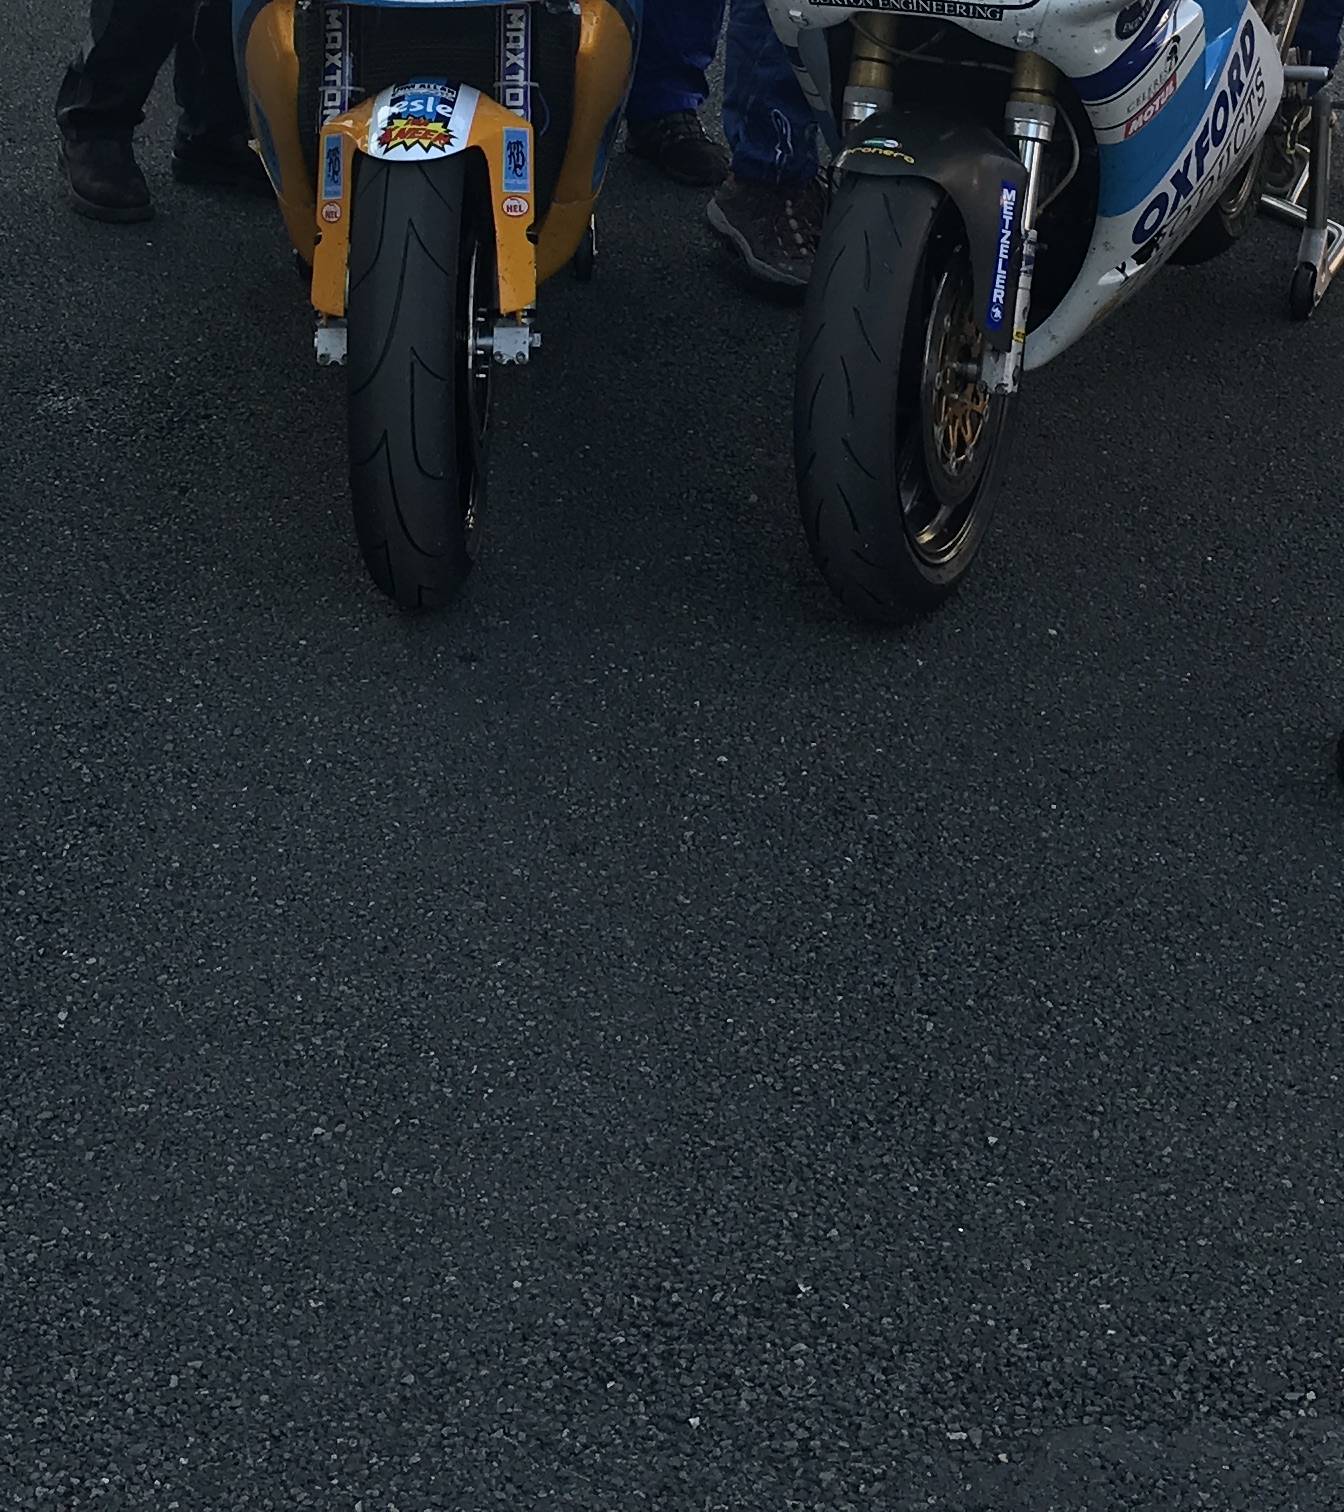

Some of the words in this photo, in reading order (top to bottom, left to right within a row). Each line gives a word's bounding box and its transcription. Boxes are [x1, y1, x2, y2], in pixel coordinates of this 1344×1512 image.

[324, 7, 344, 125] MAXTON
[1126, 78, 1176, 136] MOTUL
[1131, 18, 1256, 245] OXFORD
[506, 204, 525, 213] HEL
[990, 187, 1018, 305] METZELER
